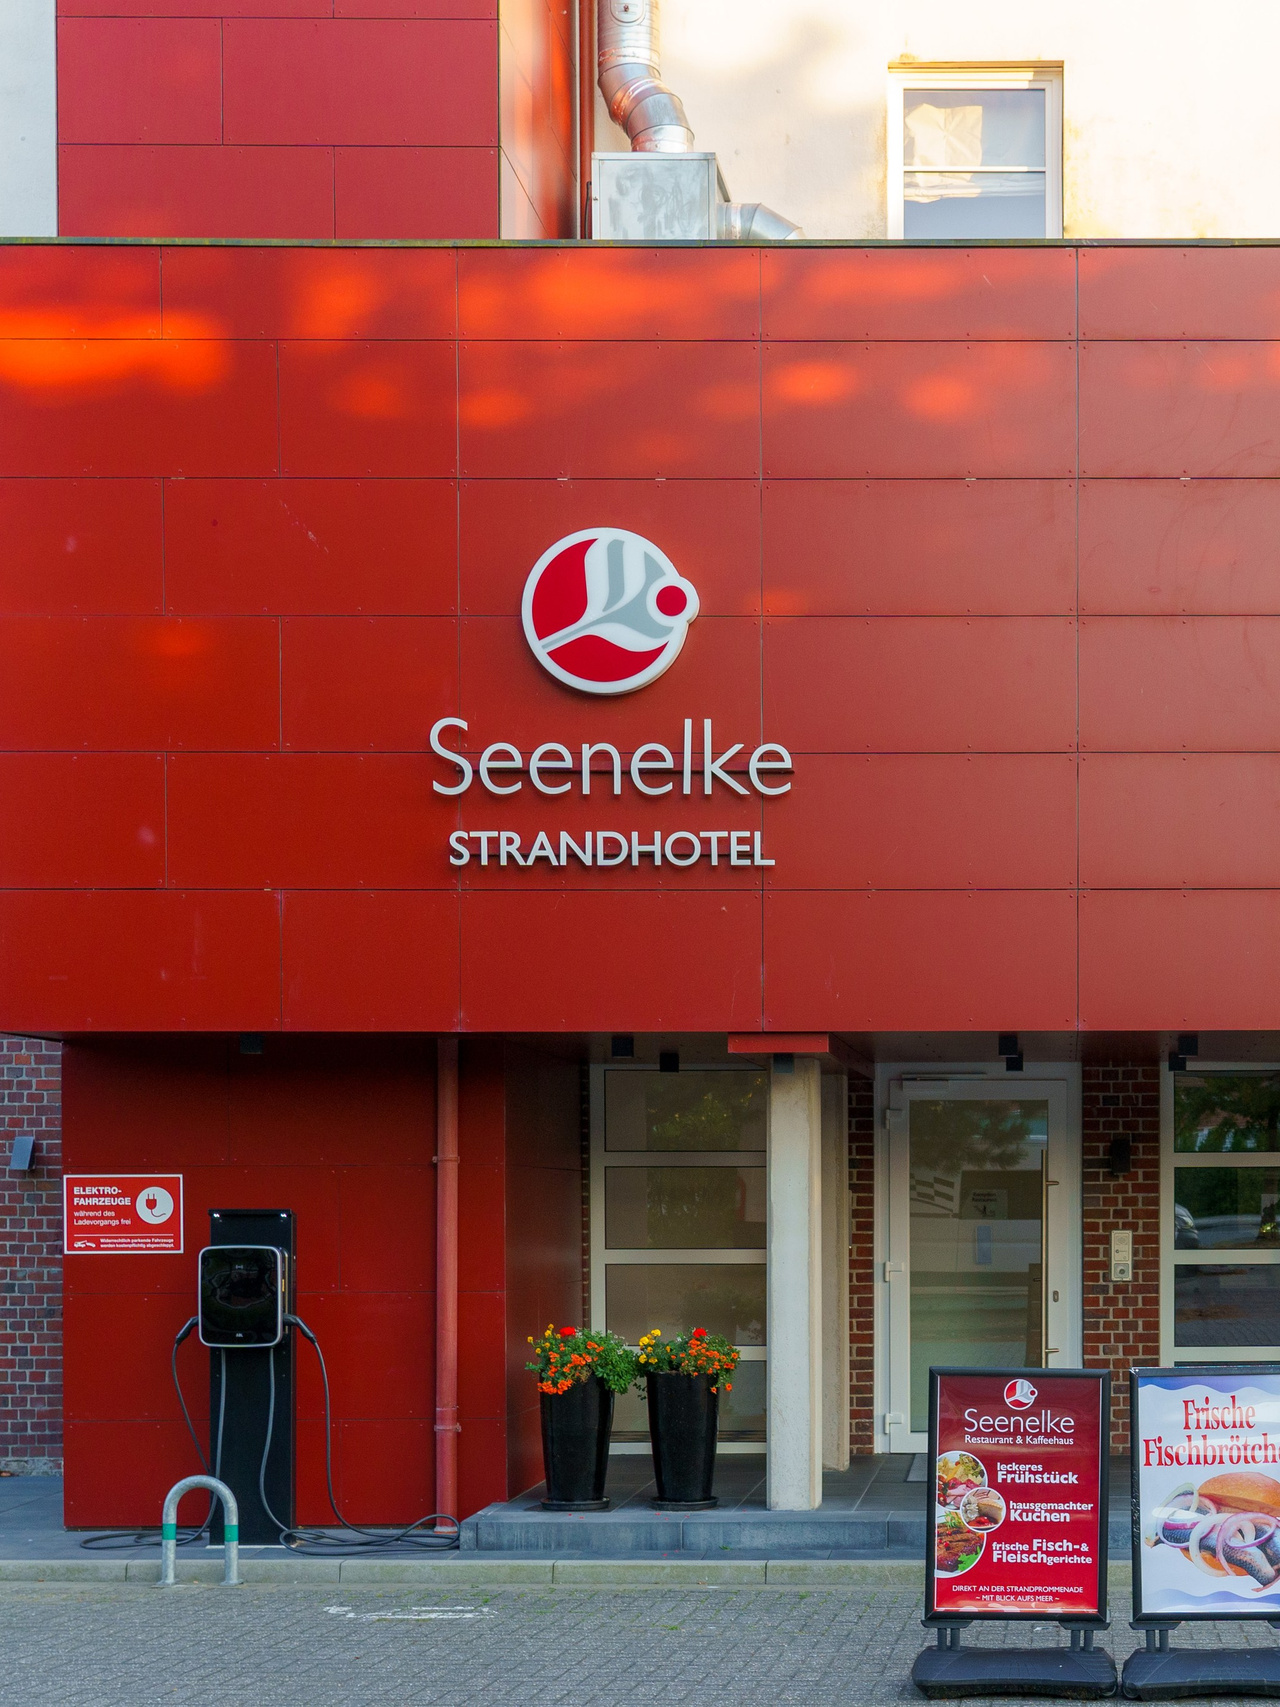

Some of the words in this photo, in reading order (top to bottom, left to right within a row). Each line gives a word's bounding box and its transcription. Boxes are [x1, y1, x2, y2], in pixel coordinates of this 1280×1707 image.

[429, 717, 793, 796] Seenelke
[449, 831, 775, 866] STRANDHOTEL
[73, 1186, 122, 1195] ELEKTRO-
[73, 1197, 132, 1206] FAHRZEUGE
[1182, 1395, 1256, 1430] Frische
[964, 1408, 1075, 1434] Seenelke
[964, 1434, 1013, 1444] Restaurant
[1016, 1436, 1023, 1444] &
[1026, 1436, 1074, 1445] Kaffeehaus
[997, 1462, 1043, 1472] leckeres
[997, 1470, 1078, 1484] Frühstück
[1010, 1500, 1093, 1512] hausgemachter
[1010, 1510, 1070, 1522] Kuchen
[992, 1541, 1029, 1550] frische
[992, 1551, 1092, 1566] Fleischgerichte
